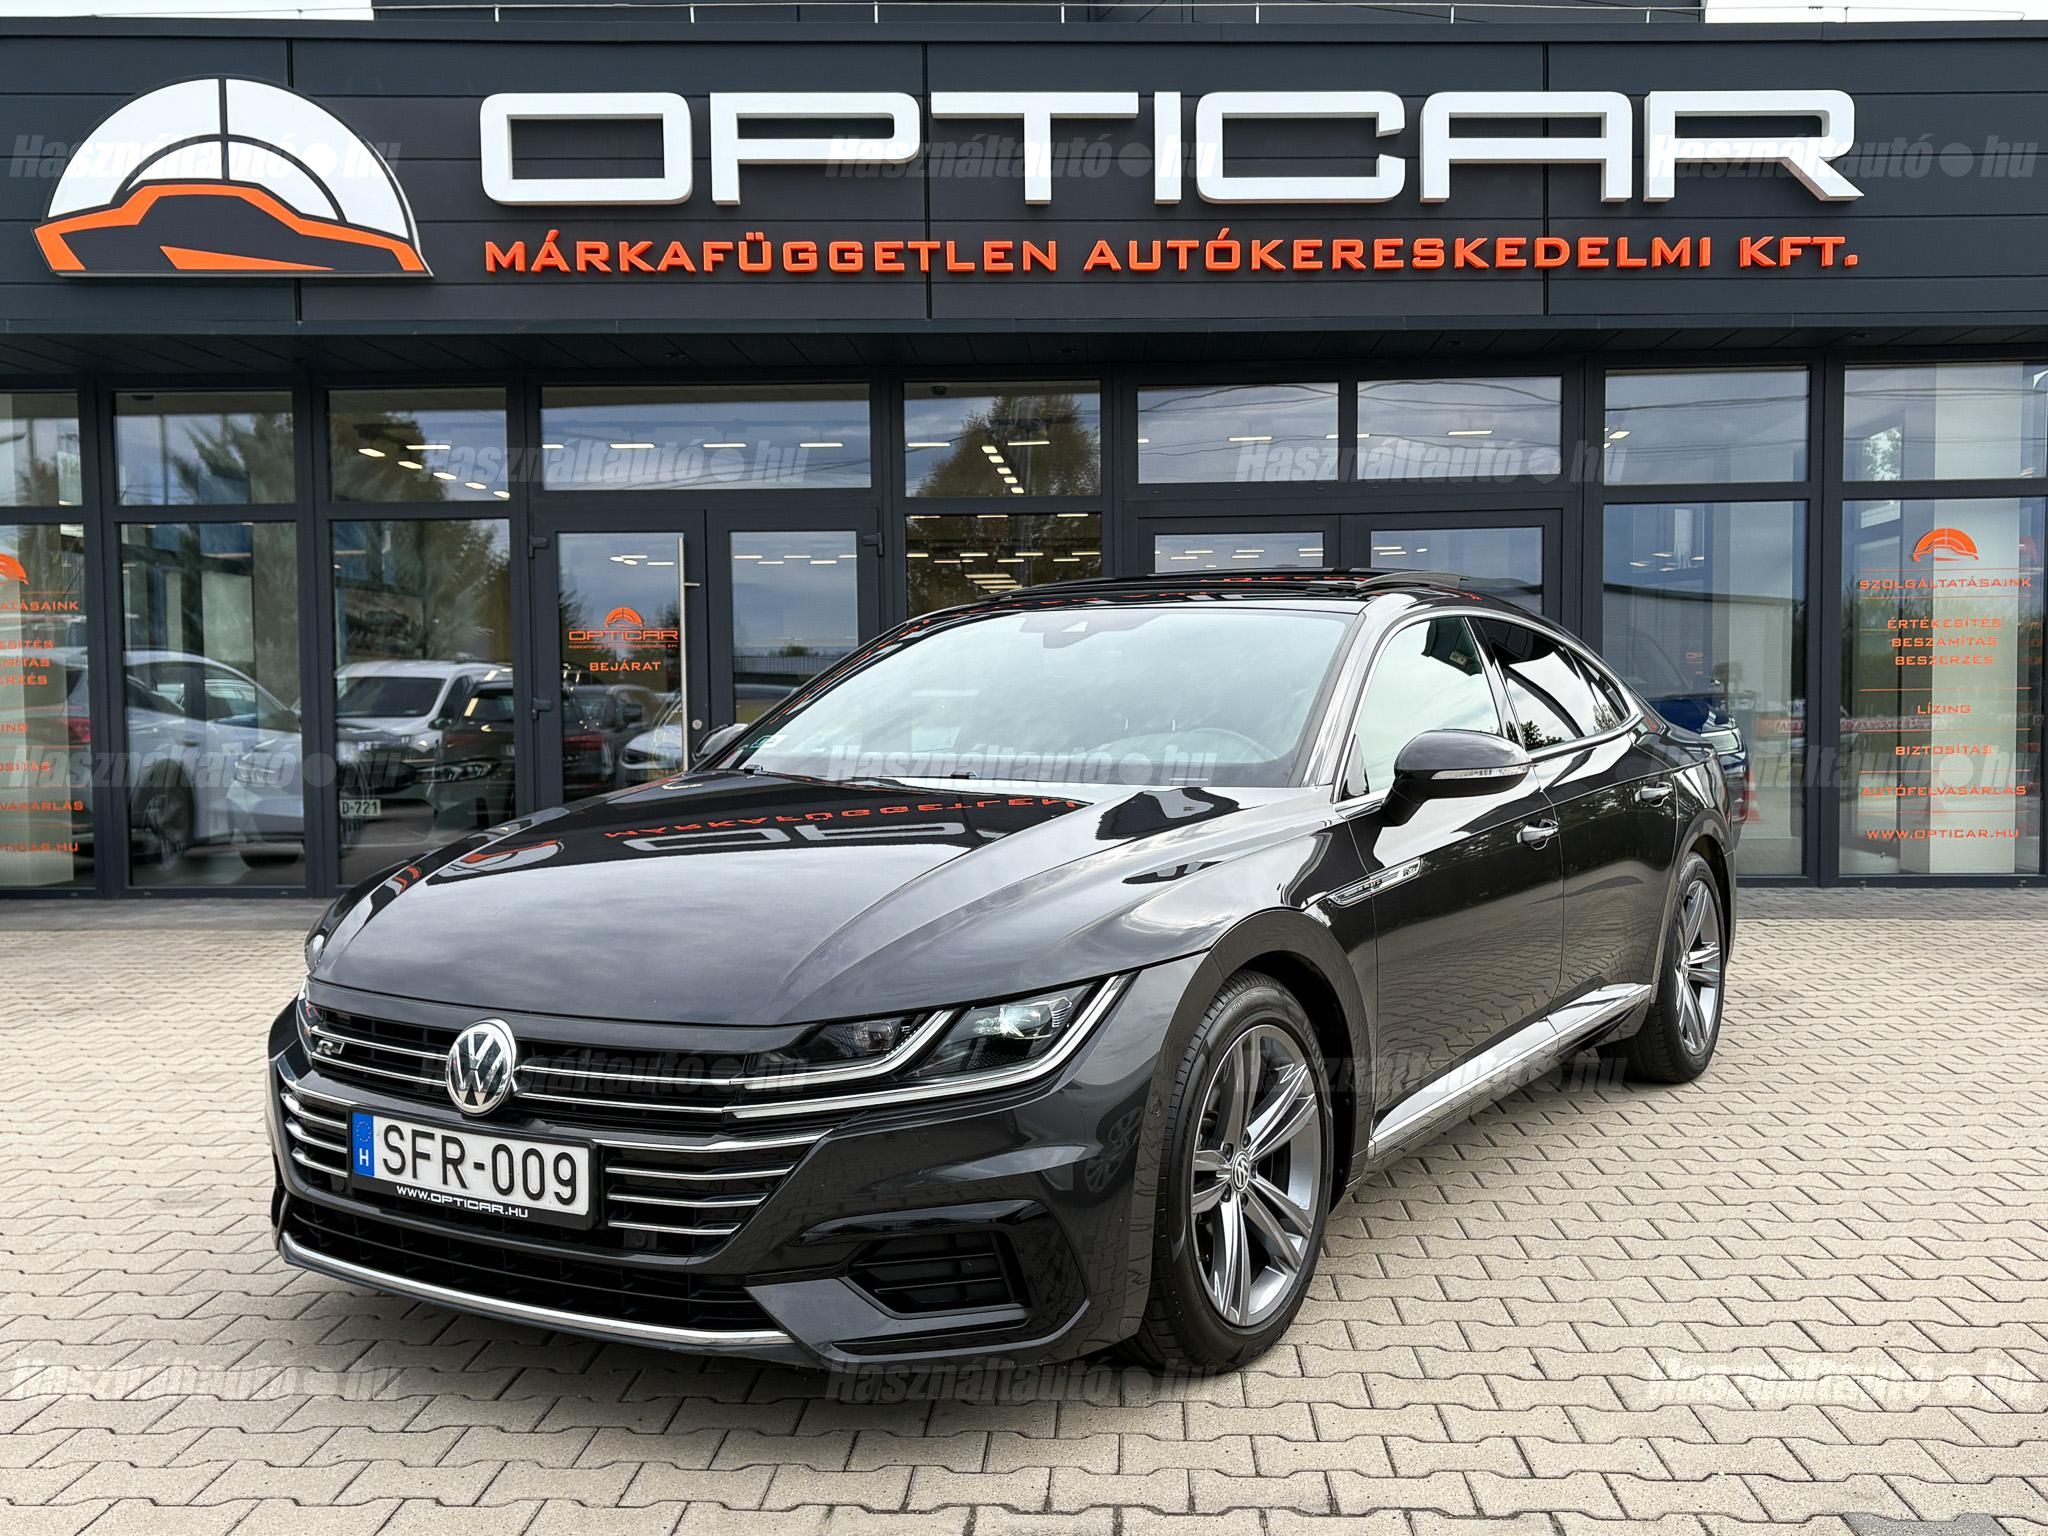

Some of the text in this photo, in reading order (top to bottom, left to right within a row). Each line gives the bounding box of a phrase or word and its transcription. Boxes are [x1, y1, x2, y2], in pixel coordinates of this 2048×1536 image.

[480, 89, 1864, 207] OPTICAR
[485, 227, 1859, 273] MÁRKAFÜGGETLEN AUTÓKERESKEDELMI KFT.
[1859, 576, 2032, 590] SZOLGÁLTATÁSAINK
[1887, 616, 2002, 629] ÉRTÉKESÍTÉS
[568, 630, 679, 641] OPTICAR
[589, 659, 661, 671] BEJÁRAT
[1916, 702, 1972, 715] LÍZING
[1866, 828, 2020, 840] WWW.OPTICAR.HU
[360, 1124, 577, 1206] H SFR-009
[396, 1185, 529, 1218] WWW.OPTICAR.HU
